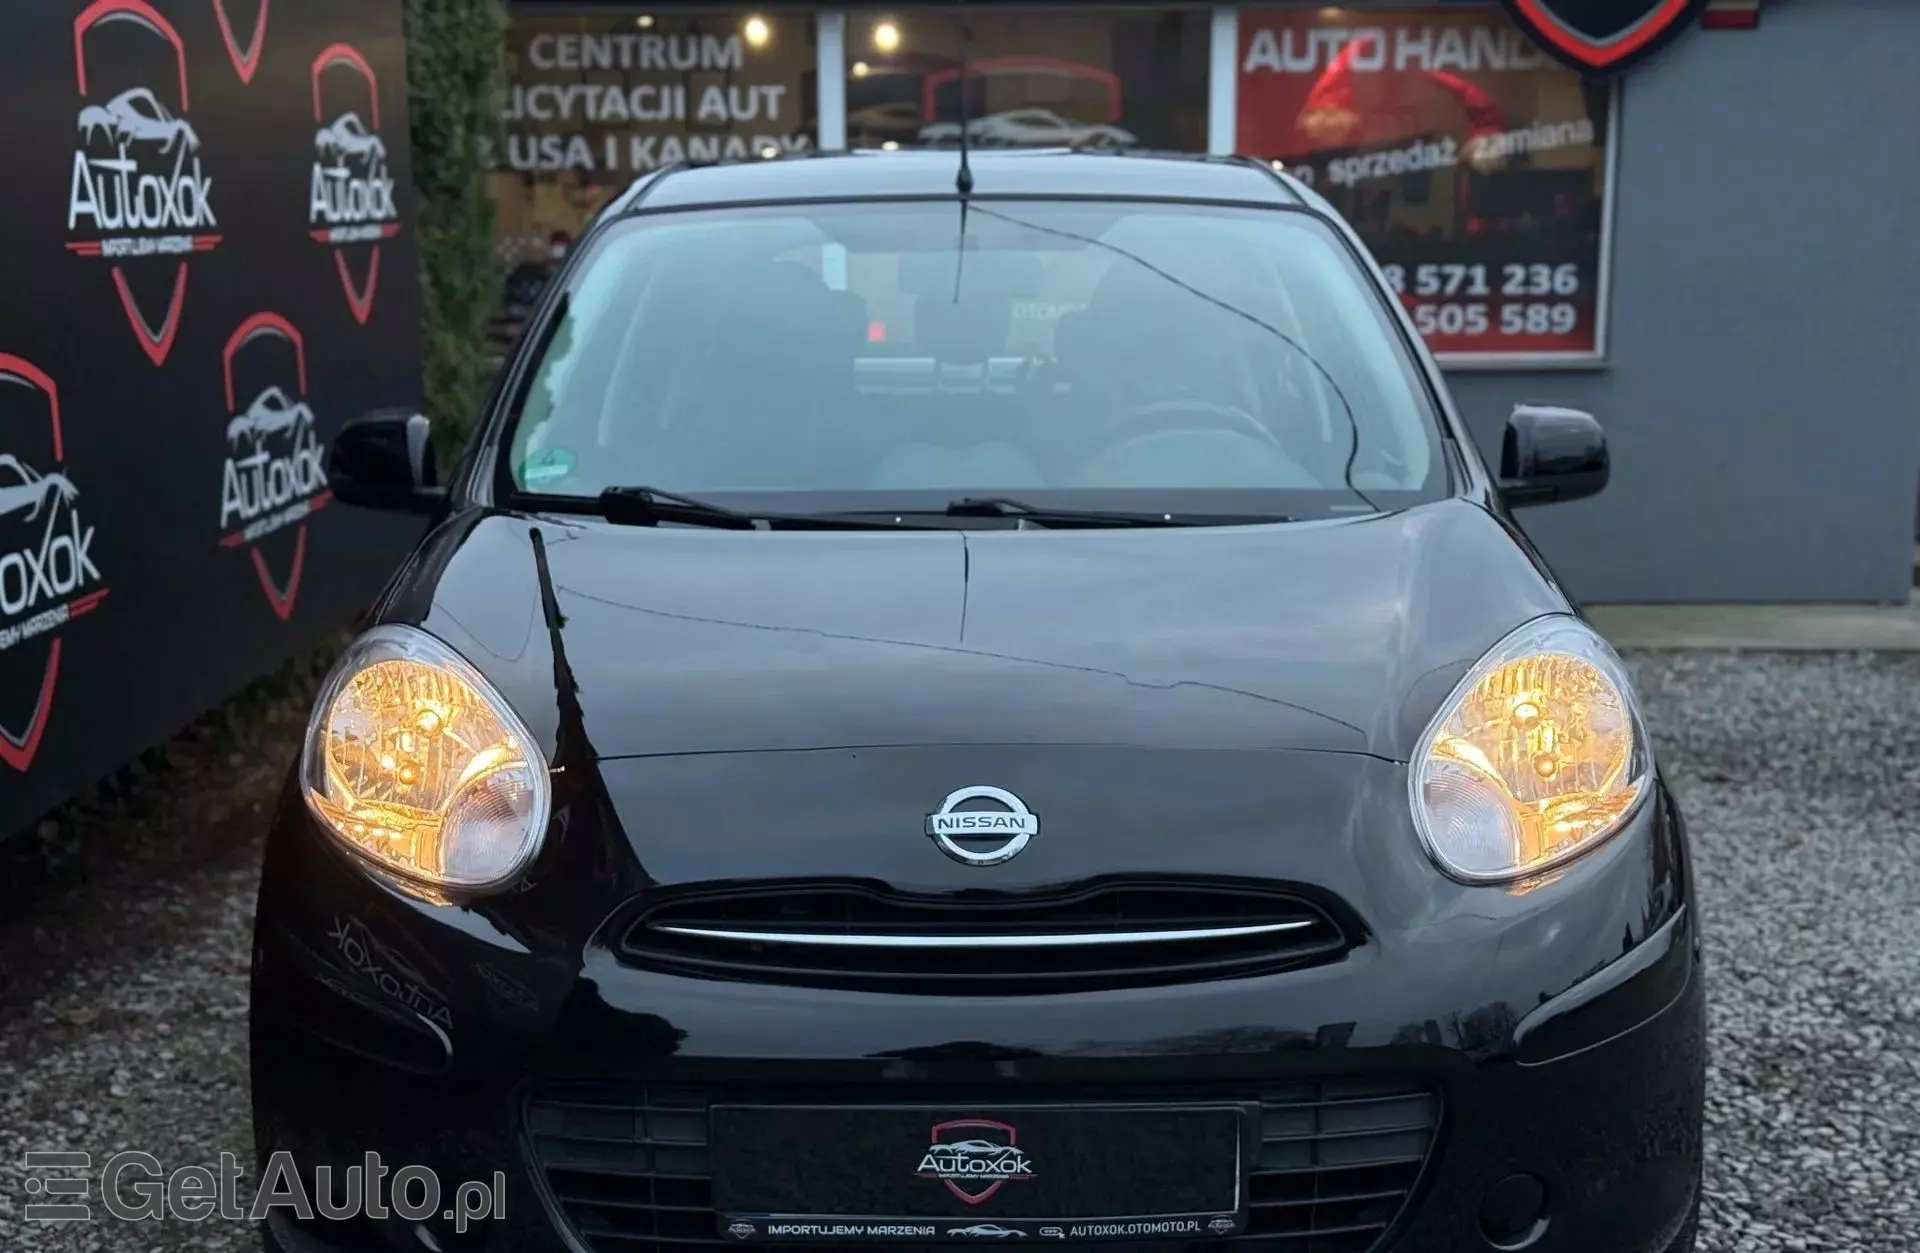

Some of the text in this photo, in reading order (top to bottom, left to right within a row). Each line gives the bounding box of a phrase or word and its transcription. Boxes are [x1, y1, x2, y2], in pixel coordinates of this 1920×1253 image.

[529, 33, 743, 70] CENTRUM
[1244, 28, 1385, 72] AUTO
[698, 84, 786, 121] AUT
[508, 134, 596, 170] USA
[1327, 137, 1458, 187] sprzedaż
[1473, 117, 1594, 161] zamiana
[68, 143, 217, 230] Autoxok
[1416, 264, 1490, 295] 571
[1501, 263, 1579, 295] 236
[1416, 303, 1577, 335] 505 589
[938, 816, 1026, 829] NISSAN
[917, 1152, 1032, 1173] Autoxok
[768, 1225, 863, 1236] IMPORTUJEMY
[867, 1225, 936, 1236] MARZENIA
[1070, 1220, 1201, 1237] AUTOXOK.OTOMOTO.PL
